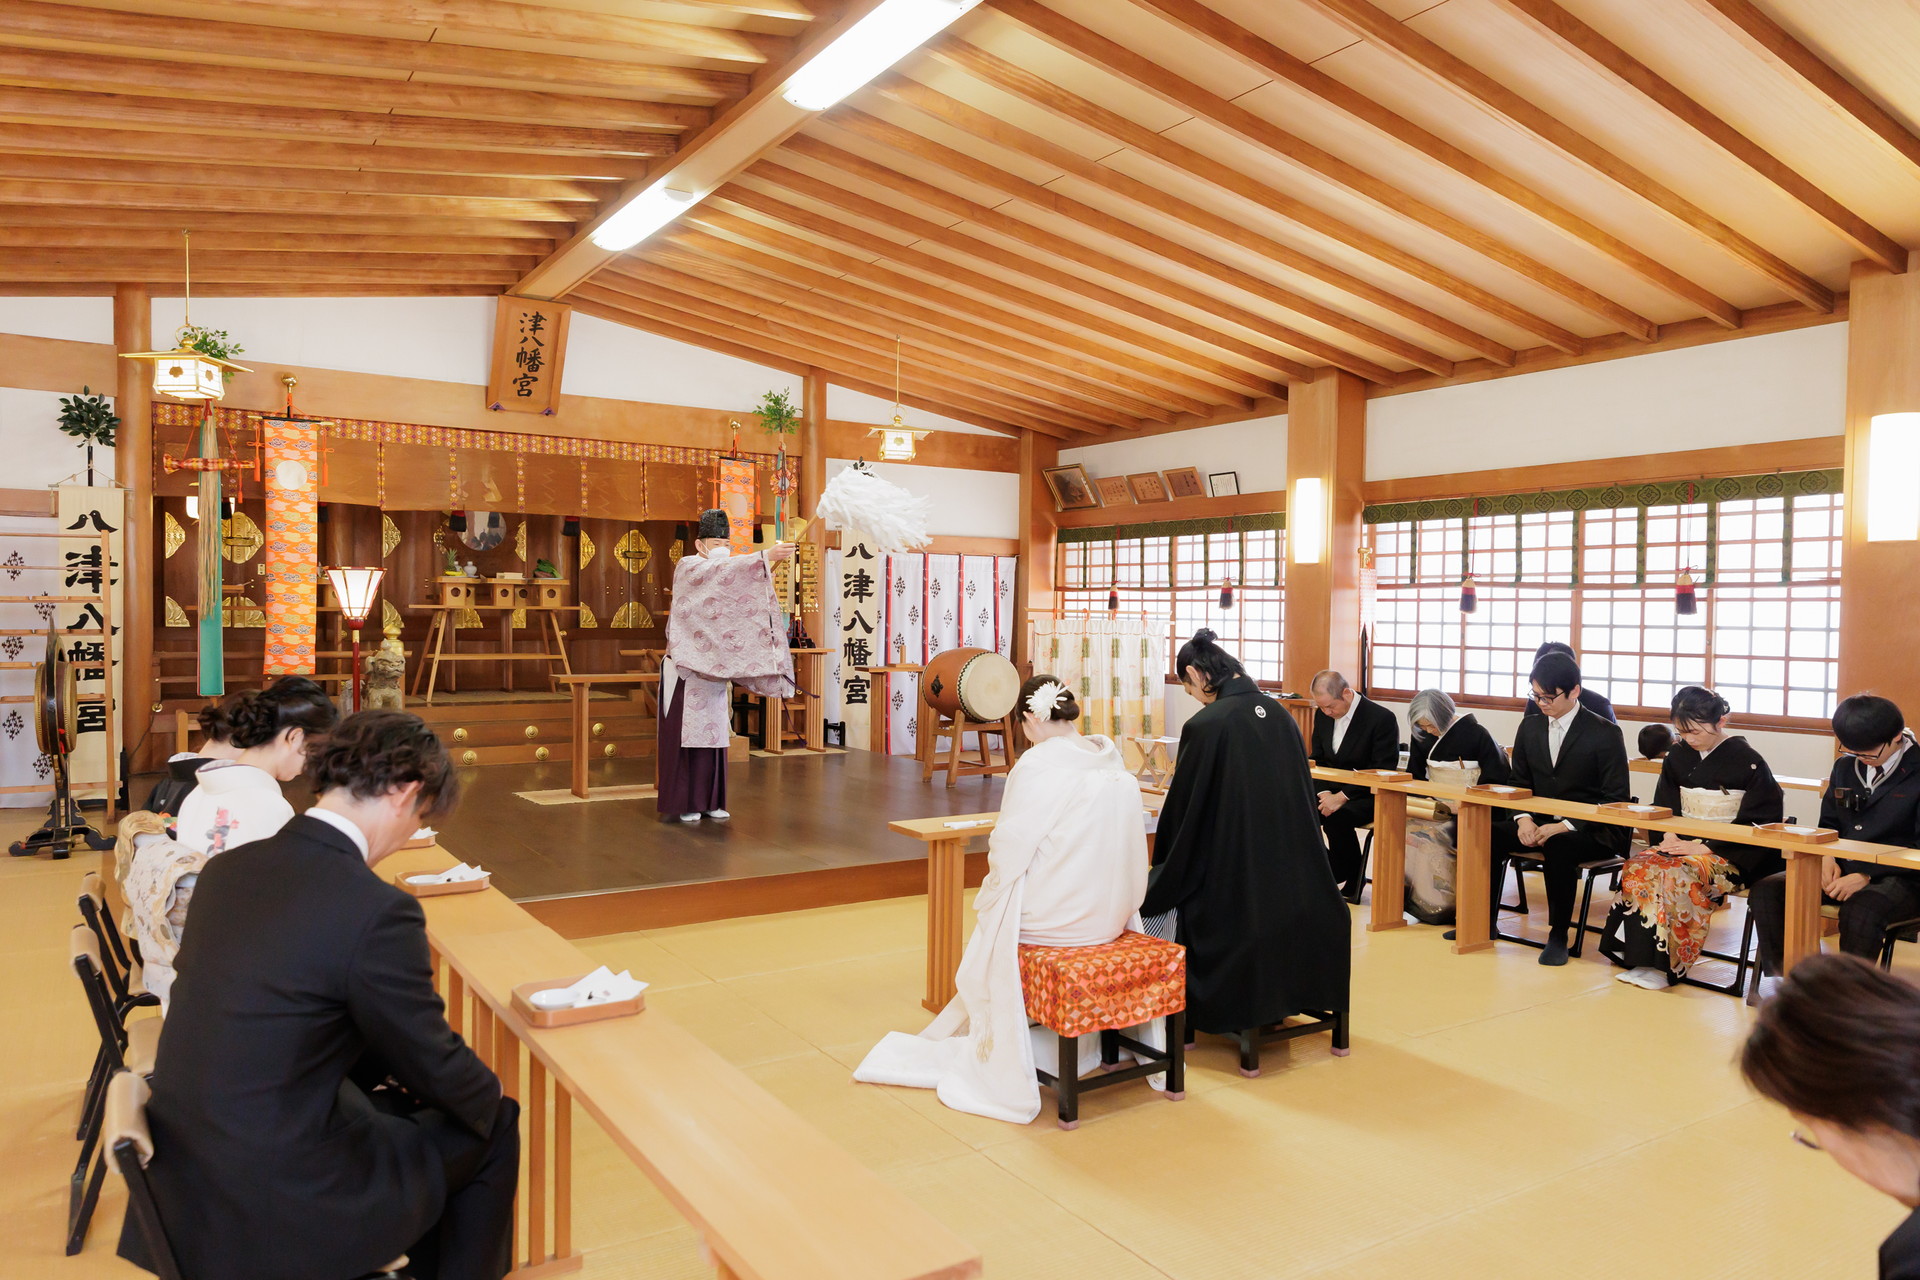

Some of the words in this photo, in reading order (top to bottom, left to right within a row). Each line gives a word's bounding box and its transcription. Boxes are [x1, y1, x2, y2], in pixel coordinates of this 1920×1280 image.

[512, 310, 548, 398] 津八幡宮
[843, 542, 875, 705] 八津八幡宮
